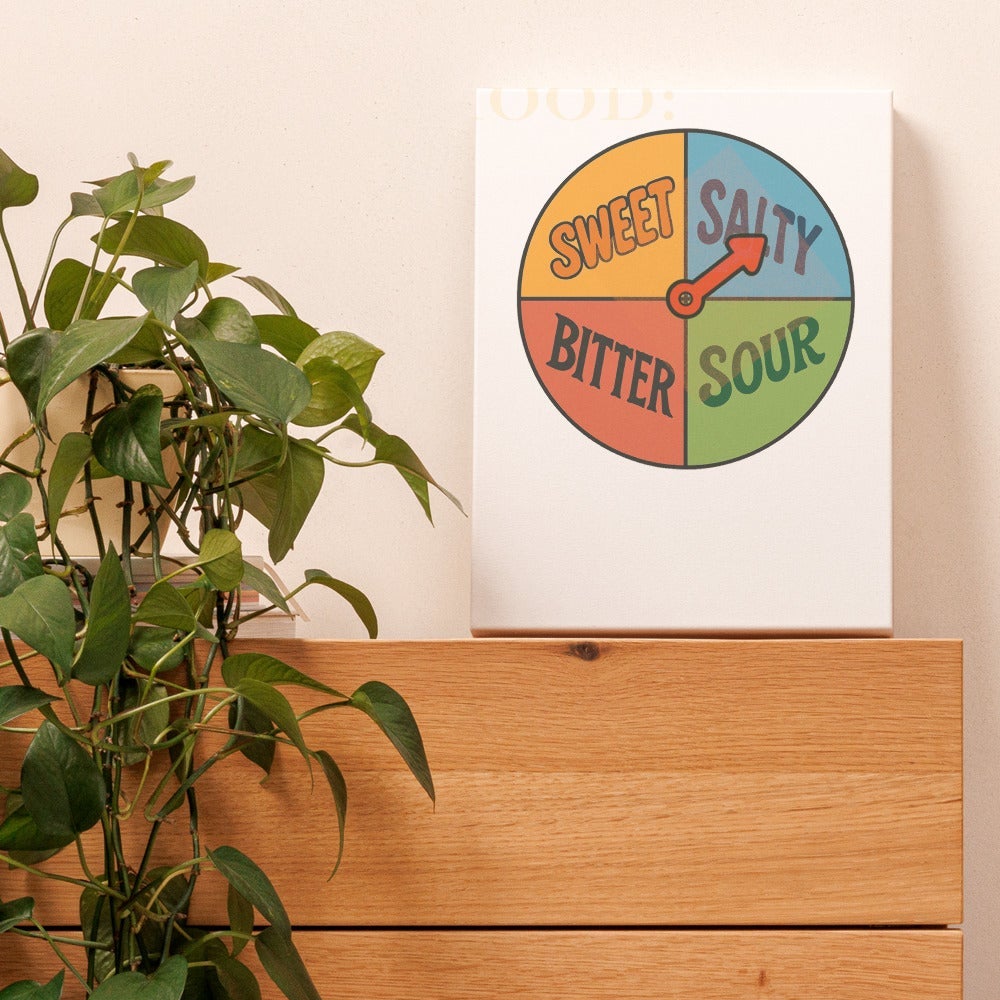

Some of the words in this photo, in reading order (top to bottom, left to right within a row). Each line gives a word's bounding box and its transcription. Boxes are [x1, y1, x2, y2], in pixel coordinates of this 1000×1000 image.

[476, 88, 674, 121] OOD:
[548, 176, 675, 279] SWEET
[697, 178, 823, 276] SALTY
[546, 312, 675, 418] BITTER
[698, 316, 825, 407] SOUR
